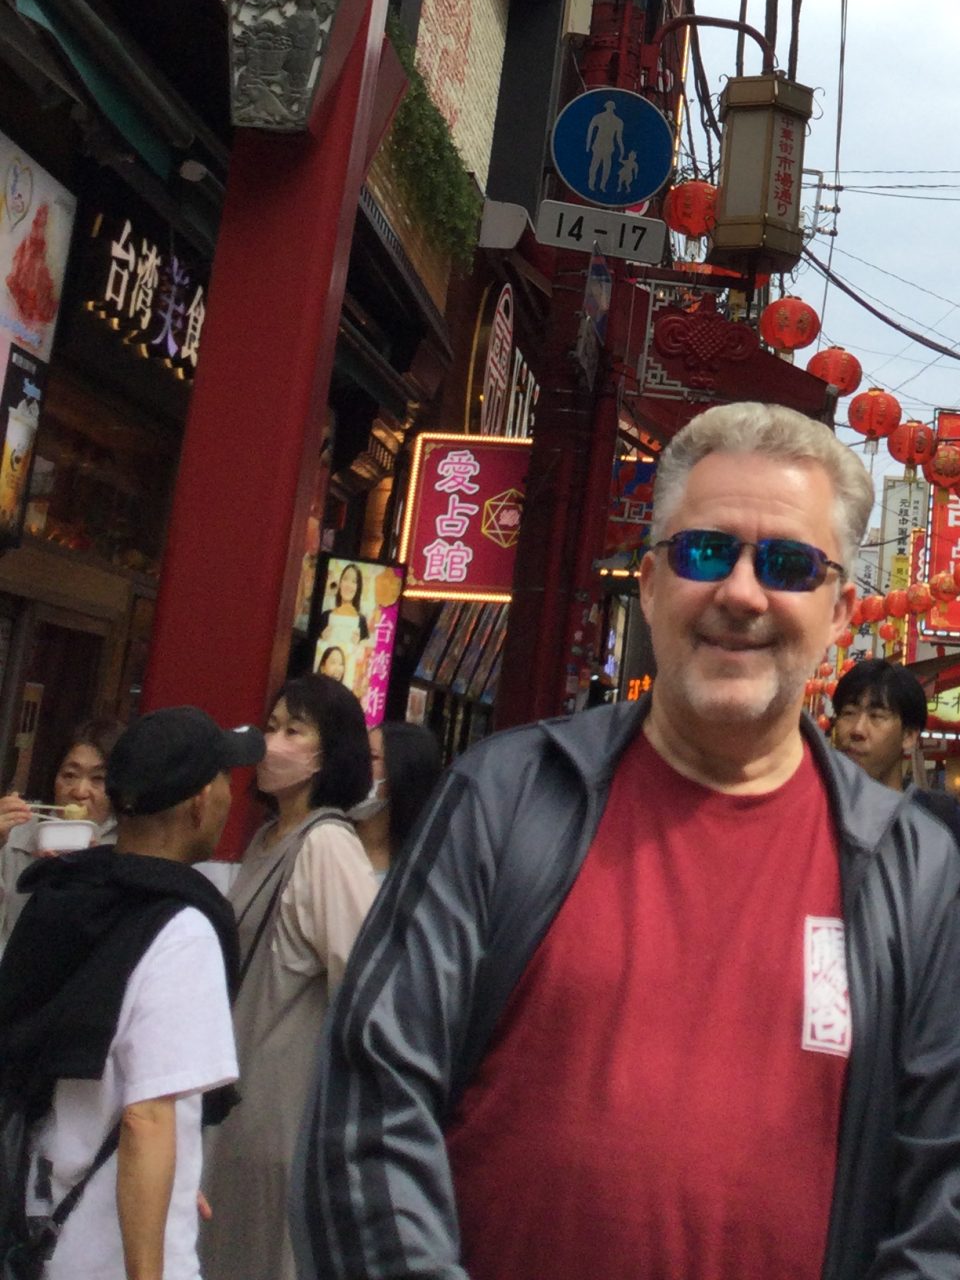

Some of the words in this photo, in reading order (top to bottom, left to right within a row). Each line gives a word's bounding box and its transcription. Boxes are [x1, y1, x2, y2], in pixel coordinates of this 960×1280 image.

[556, 212, 648, 252] 14-17
[423, 449, 481, 583] 愛占館
